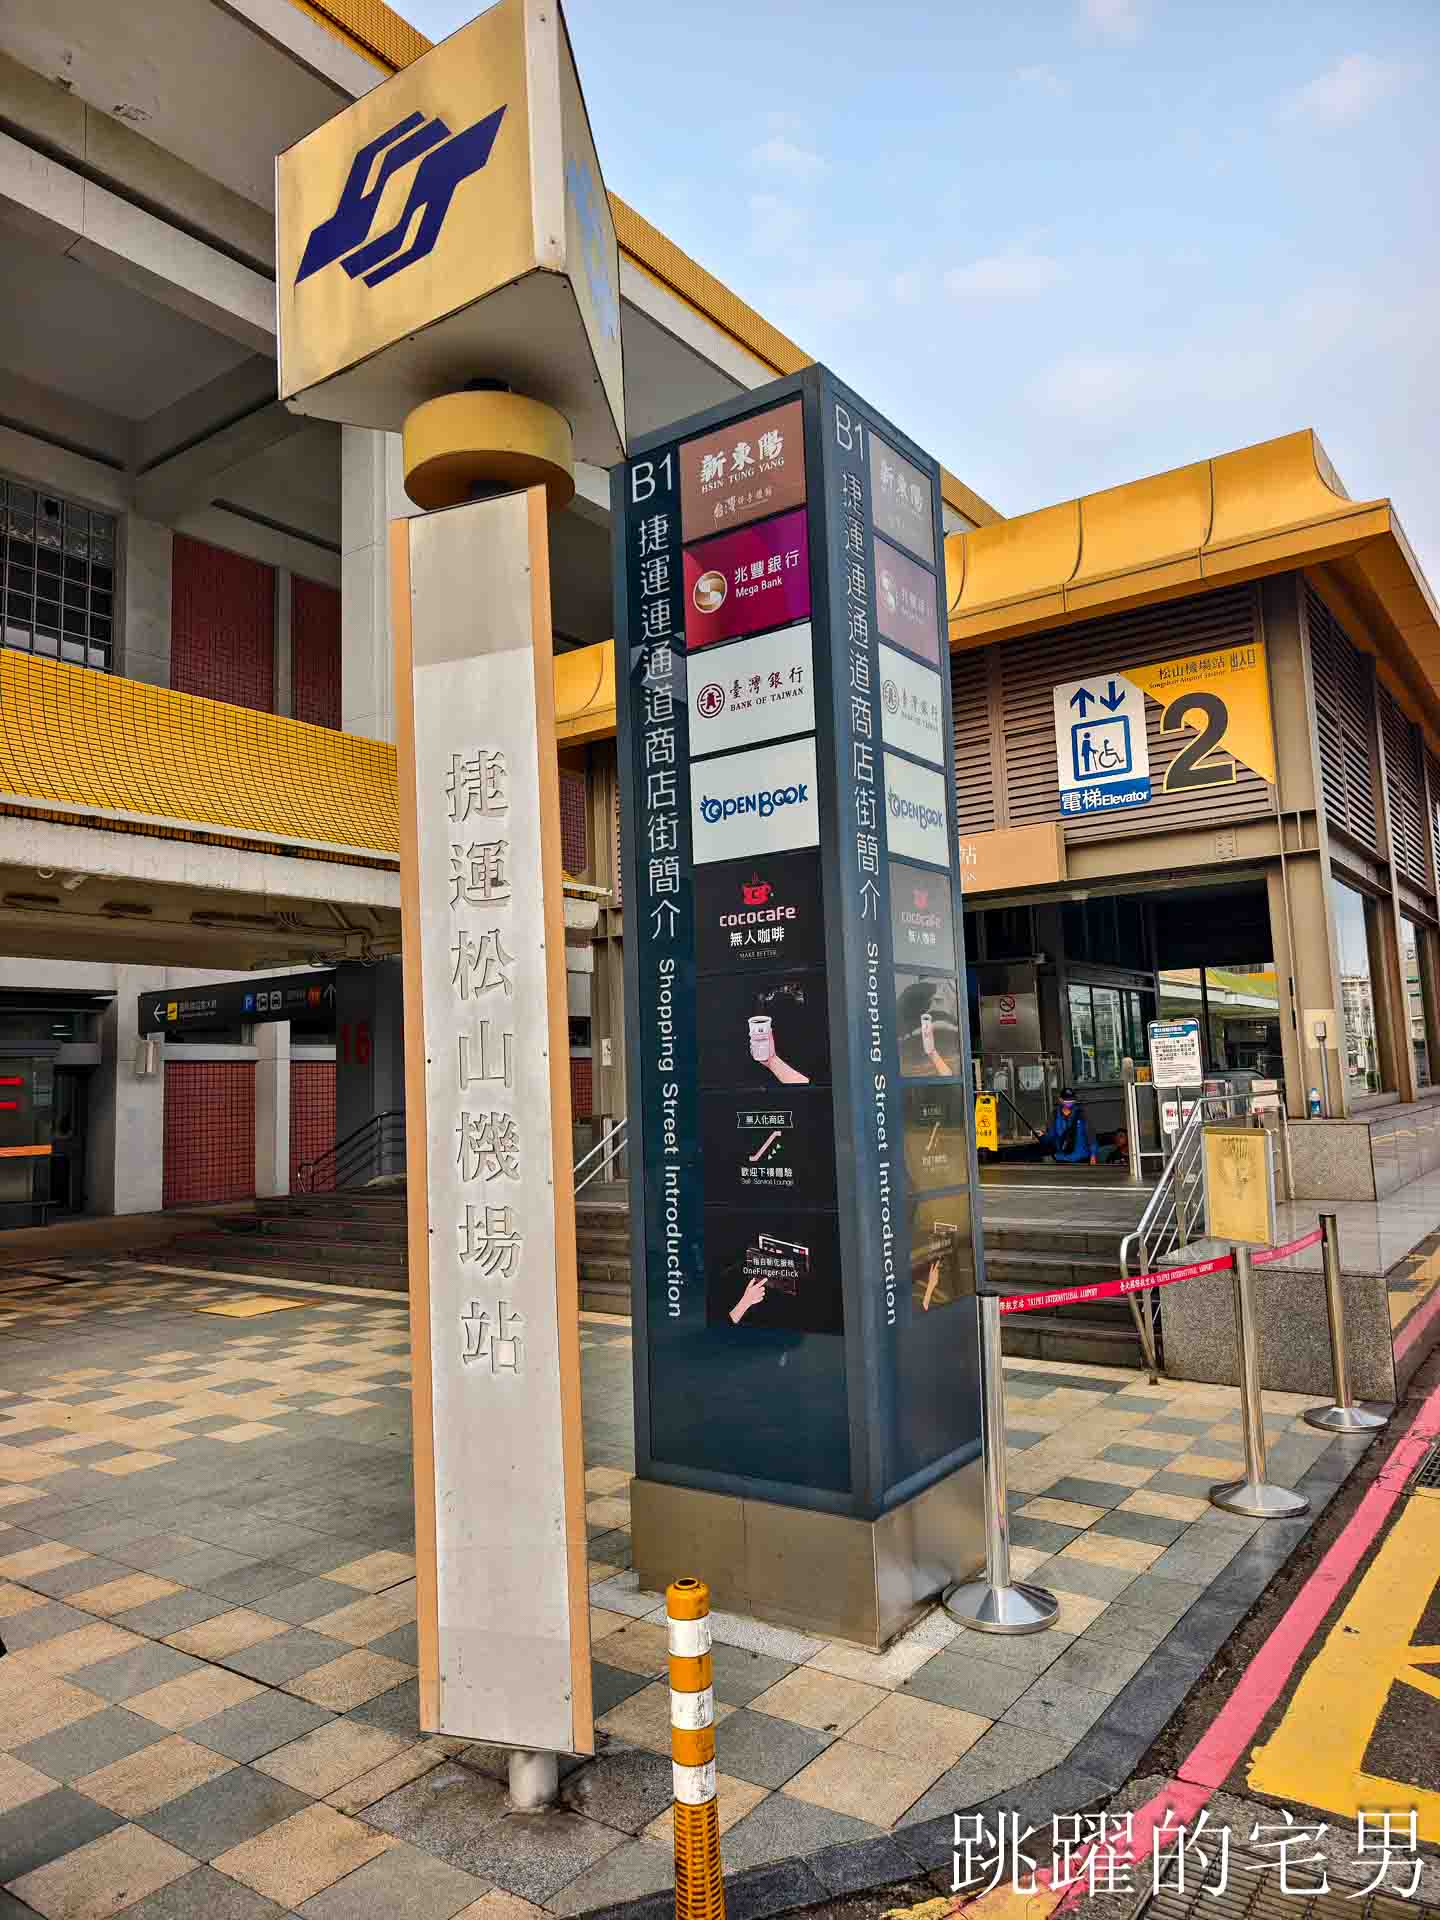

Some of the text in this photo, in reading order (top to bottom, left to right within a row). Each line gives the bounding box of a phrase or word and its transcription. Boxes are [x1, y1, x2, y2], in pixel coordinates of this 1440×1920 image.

[700, 430, 784, 483] 新東陽
[835, 404, 865, 462] B1
[631, 453, 673, 504] B1
[702, 457, 784, 494] HSIN TUNG YANG
[734, 550, 800, 585] 兆豐銀行
[735, 576, 783, 599] Mega Bank
[729, 666, 804, 698] 臺灣銀行
[730, 687, 805, 712] BANK OF TAIWAN
[637, 513, 681, 940] 捷運連通道商店街簡介
[1160, 691, 1236, 793] 2
[1062, 787, 1149, 811] 電梯 Elevator
[730, 926, 785, 947] 無人咖啡
[445, 750, 522, 1375] 捷運松山機場站
[658, 959, 683, 1318] Shopping Street Introduction
[866, 942, 897, 1325] Shopping Street Introduction
